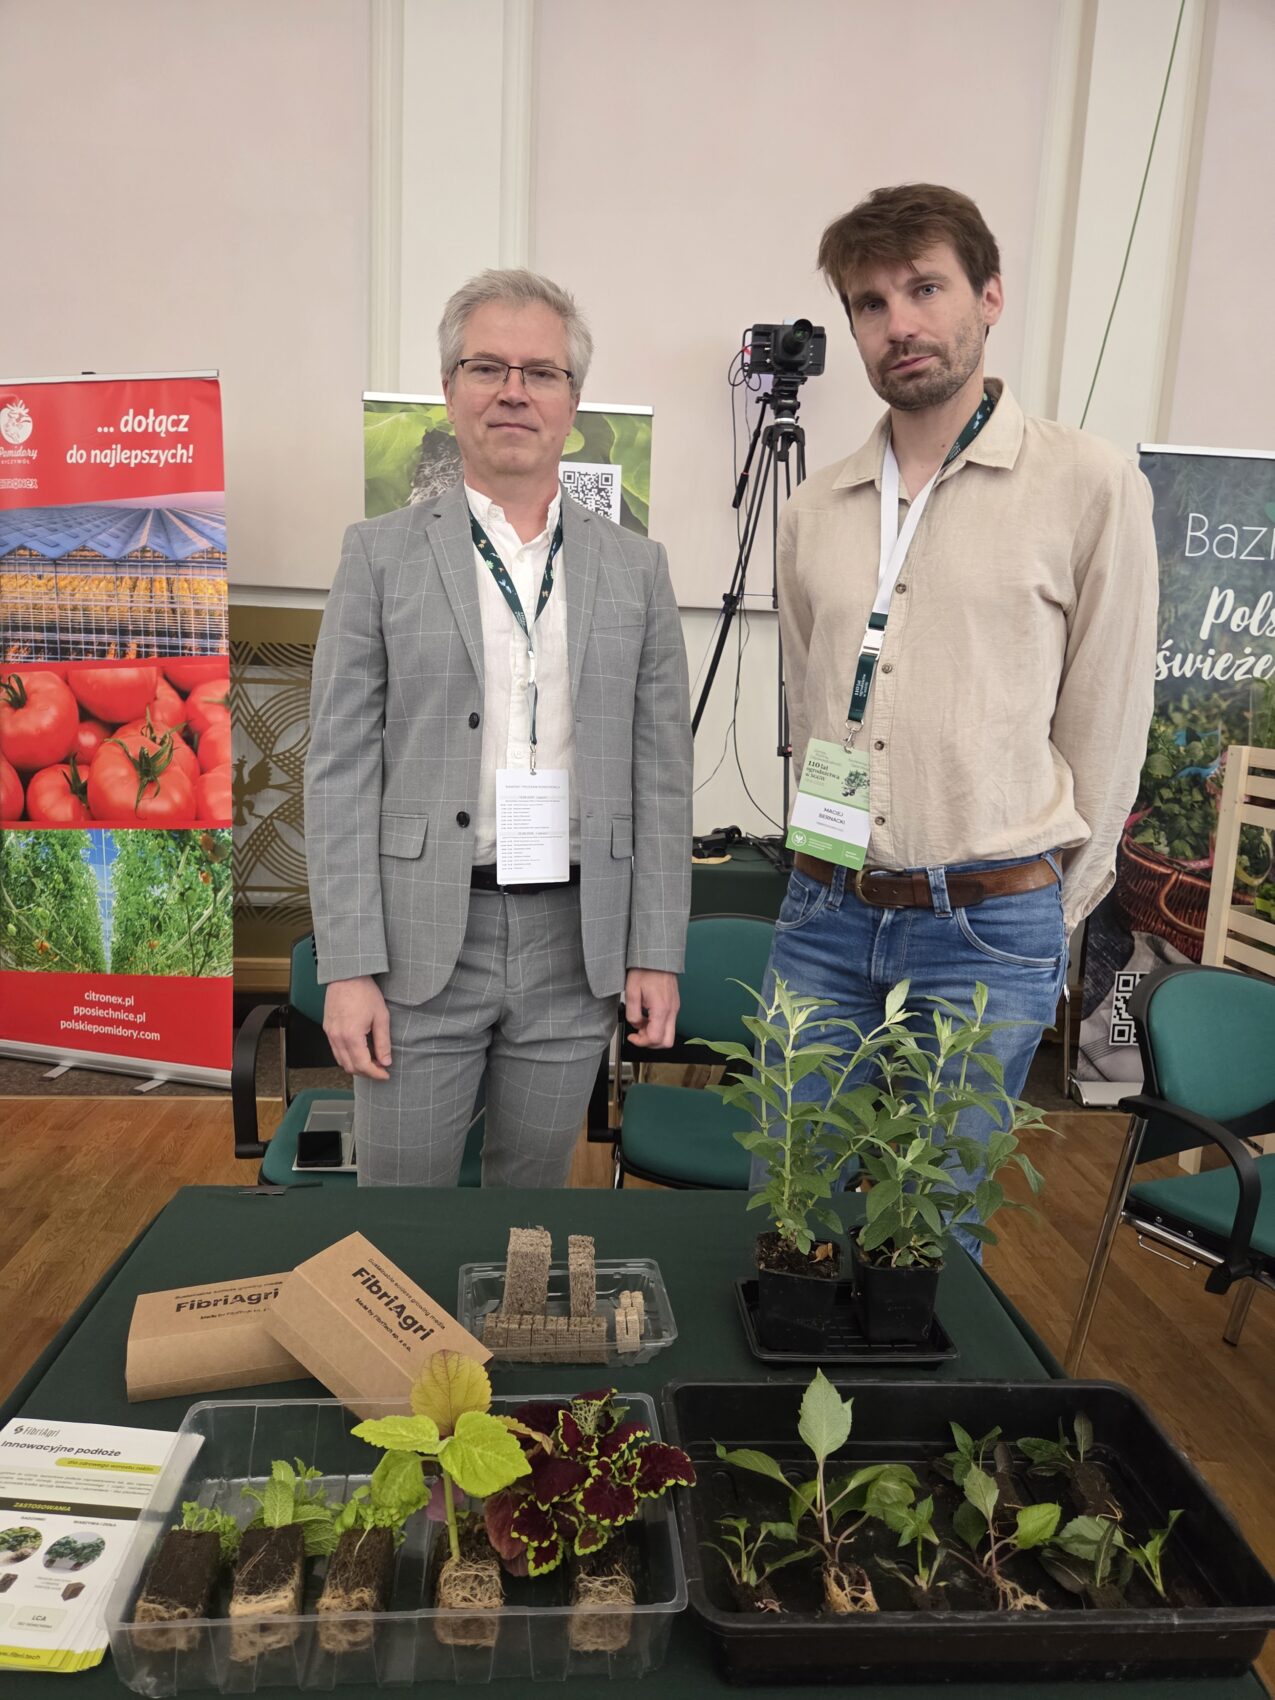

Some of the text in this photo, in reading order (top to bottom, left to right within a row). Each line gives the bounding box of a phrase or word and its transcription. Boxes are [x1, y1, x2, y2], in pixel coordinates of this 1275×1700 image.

[120, 408, 190, 437] dołącz
[66, 444, 193, 467] do najlepszych!
[1155, 639, 1275, 681] świeże
[85, 990, 134, 1006] citronex.pl
[73, 1005, 146, 1023] pposiechnice.pl
[60, 1019, 161, 1041] polskiepomidory.com
[175, 1288, 279, 1312] FibriAgri
[351, 1267, 435, 1341] FibriAgri
[23, 1426, 61, 1438] FibriAgri
[1, 1440, 122, 1457] Innowacyjne podłoże
[13, 1502, 71, 1512] ZASTOSOWANIA
